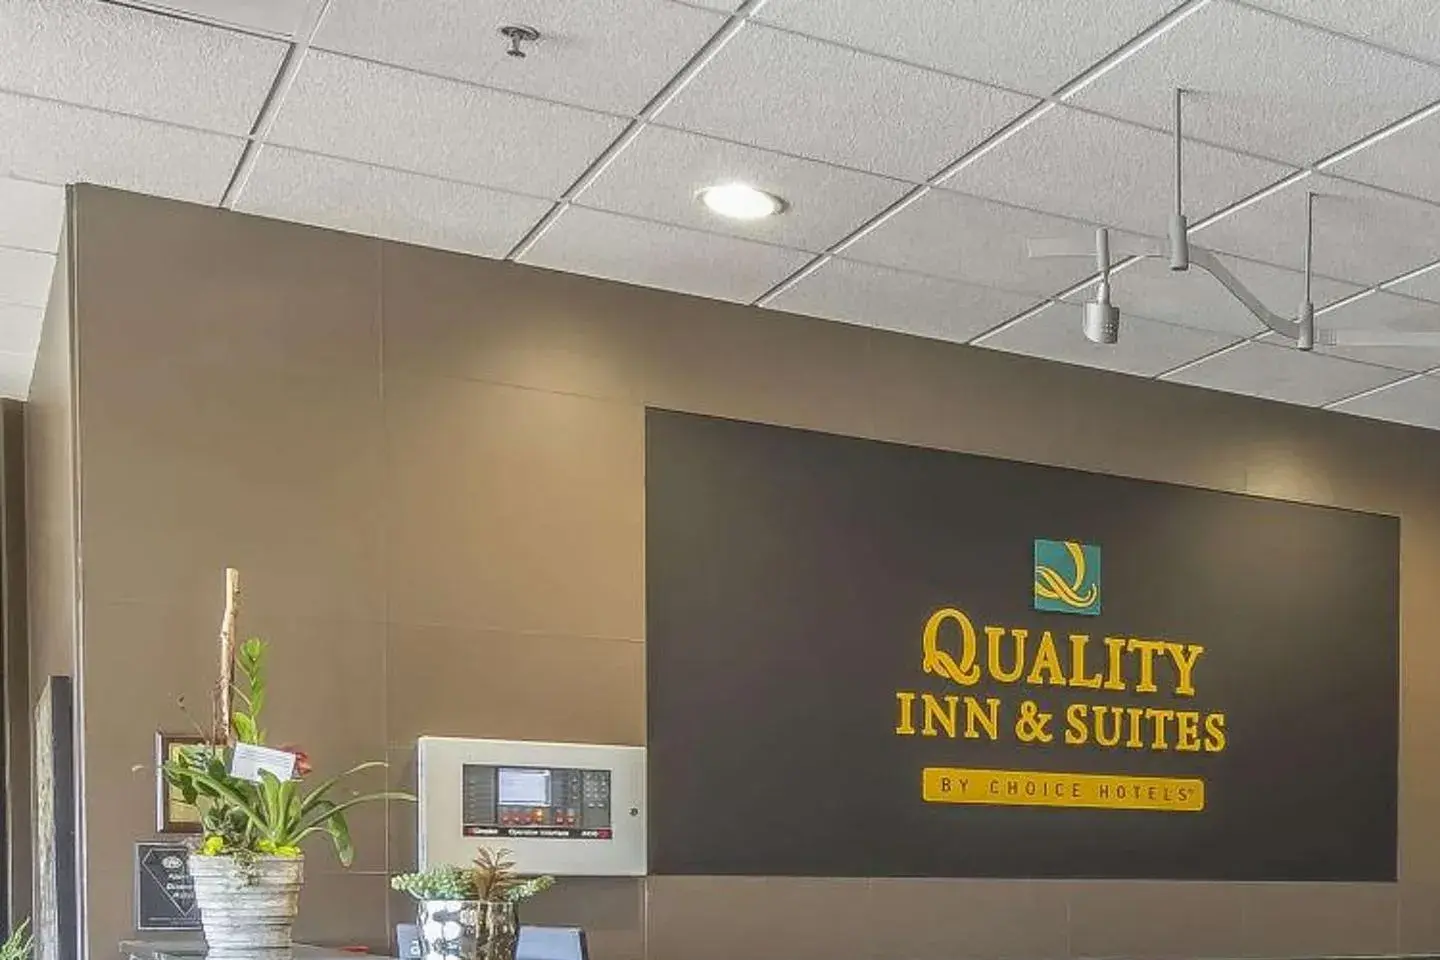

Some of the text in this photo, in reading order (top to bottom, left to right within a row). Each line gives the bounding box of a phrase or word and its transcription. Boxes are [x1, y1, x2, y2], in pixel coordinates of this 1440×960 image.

[922, 608, 1204, 696] QUALITY
[895, 691, 1227, 751] INN & SUITES
[940, 777, 969, 793] BY
[989, 780, 1083, 798] CHOICE
